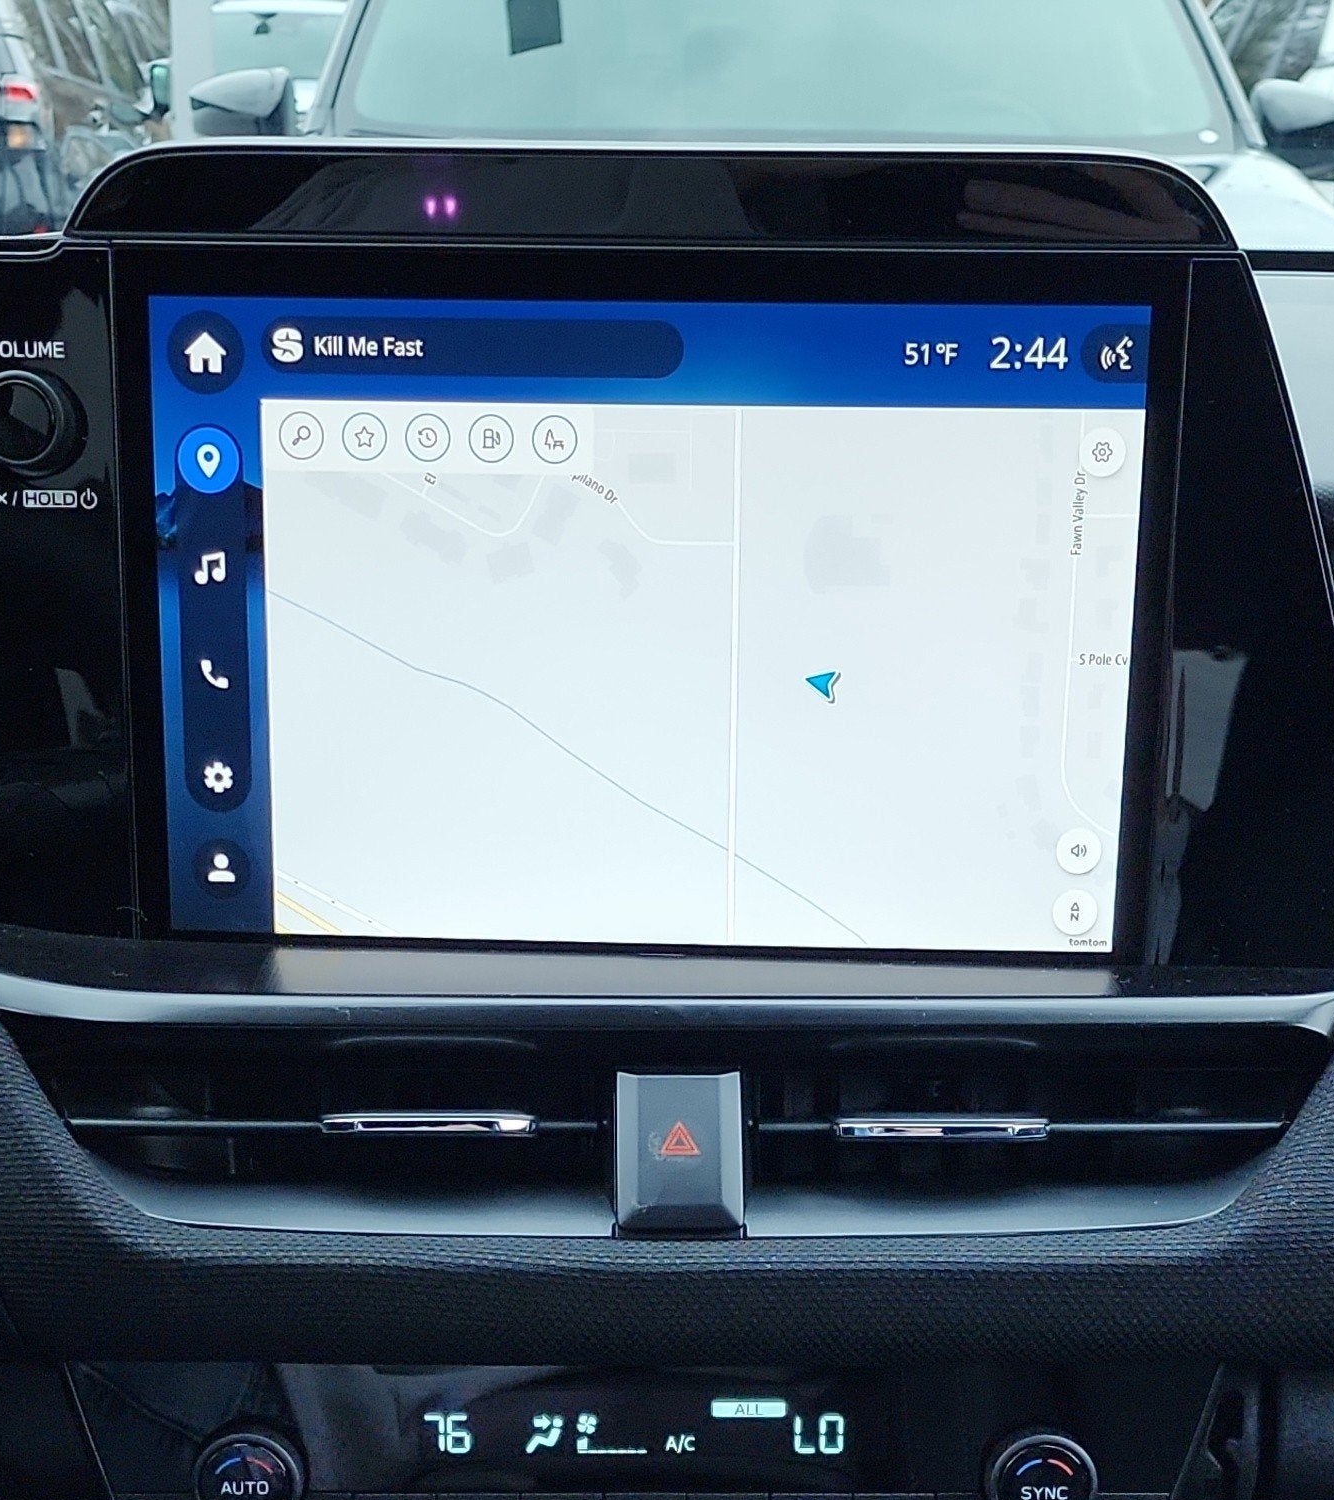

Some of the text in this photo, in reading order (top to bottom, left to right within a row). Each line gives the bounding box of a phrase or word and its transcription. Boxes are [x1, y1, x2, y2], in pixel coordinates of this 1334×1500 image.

[313, 335, 424, 357] Kill Me Fast
[989, 336, 1068, 370] 2:44
[23, 490, 77, 507] HOLD
[1070, 471, 1088, 556] Fawn Valley Dr
[1079, 653, 1129, 666] S Pole Cv
[1068, 938, 1108, 947] tomtom
[733, 1402, 764, 1416] ALL
[423, 1411, 473, 1455] 76
[664, 1434, 696, 1454] A/C
[220, 1480, 270, 1496] AUTO
[1020, 1485, 1069, 1500] SYNC
